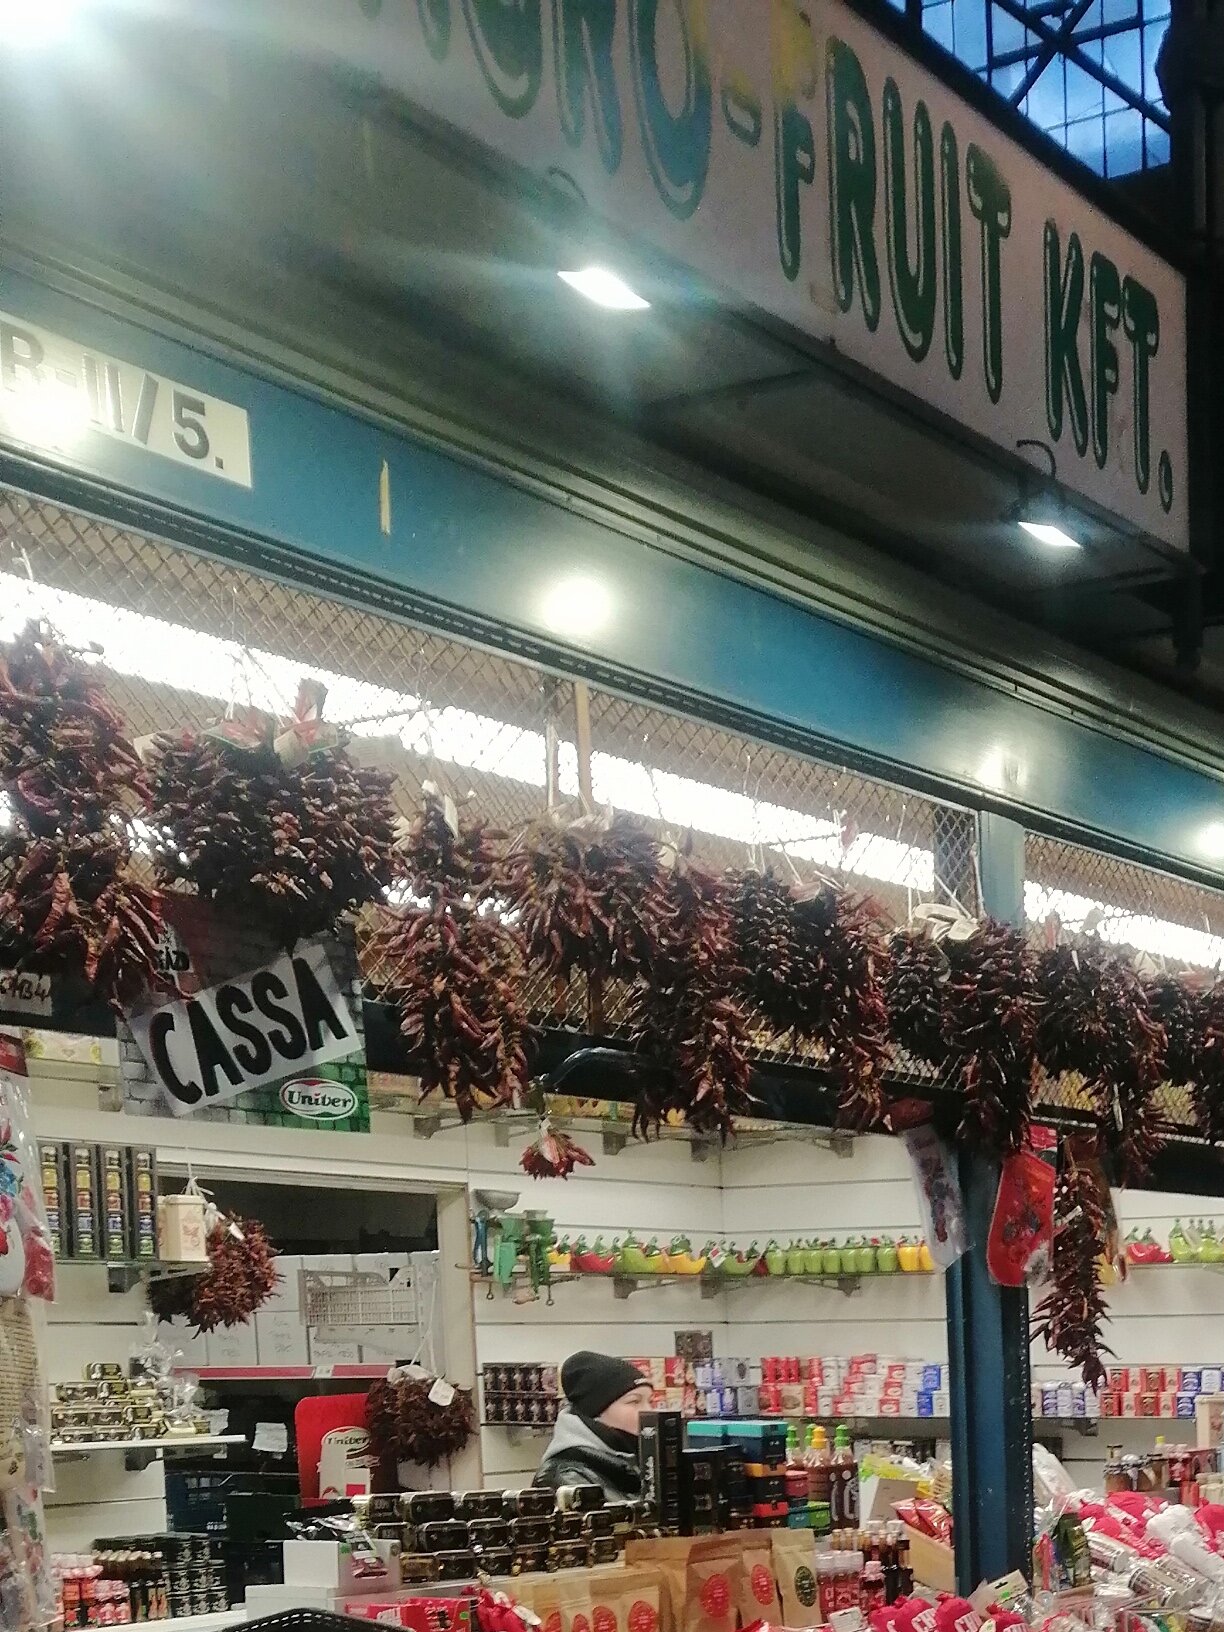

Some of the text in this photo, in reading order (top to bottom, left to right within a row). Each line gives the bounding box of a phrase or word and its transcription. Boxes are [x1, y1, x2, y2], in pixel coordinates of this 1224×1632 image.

[1044, 218, 1174, 514] KFT.
[150, 957, 349, 1105] CASSA
[287, 1090, 352, 1108] Univer
